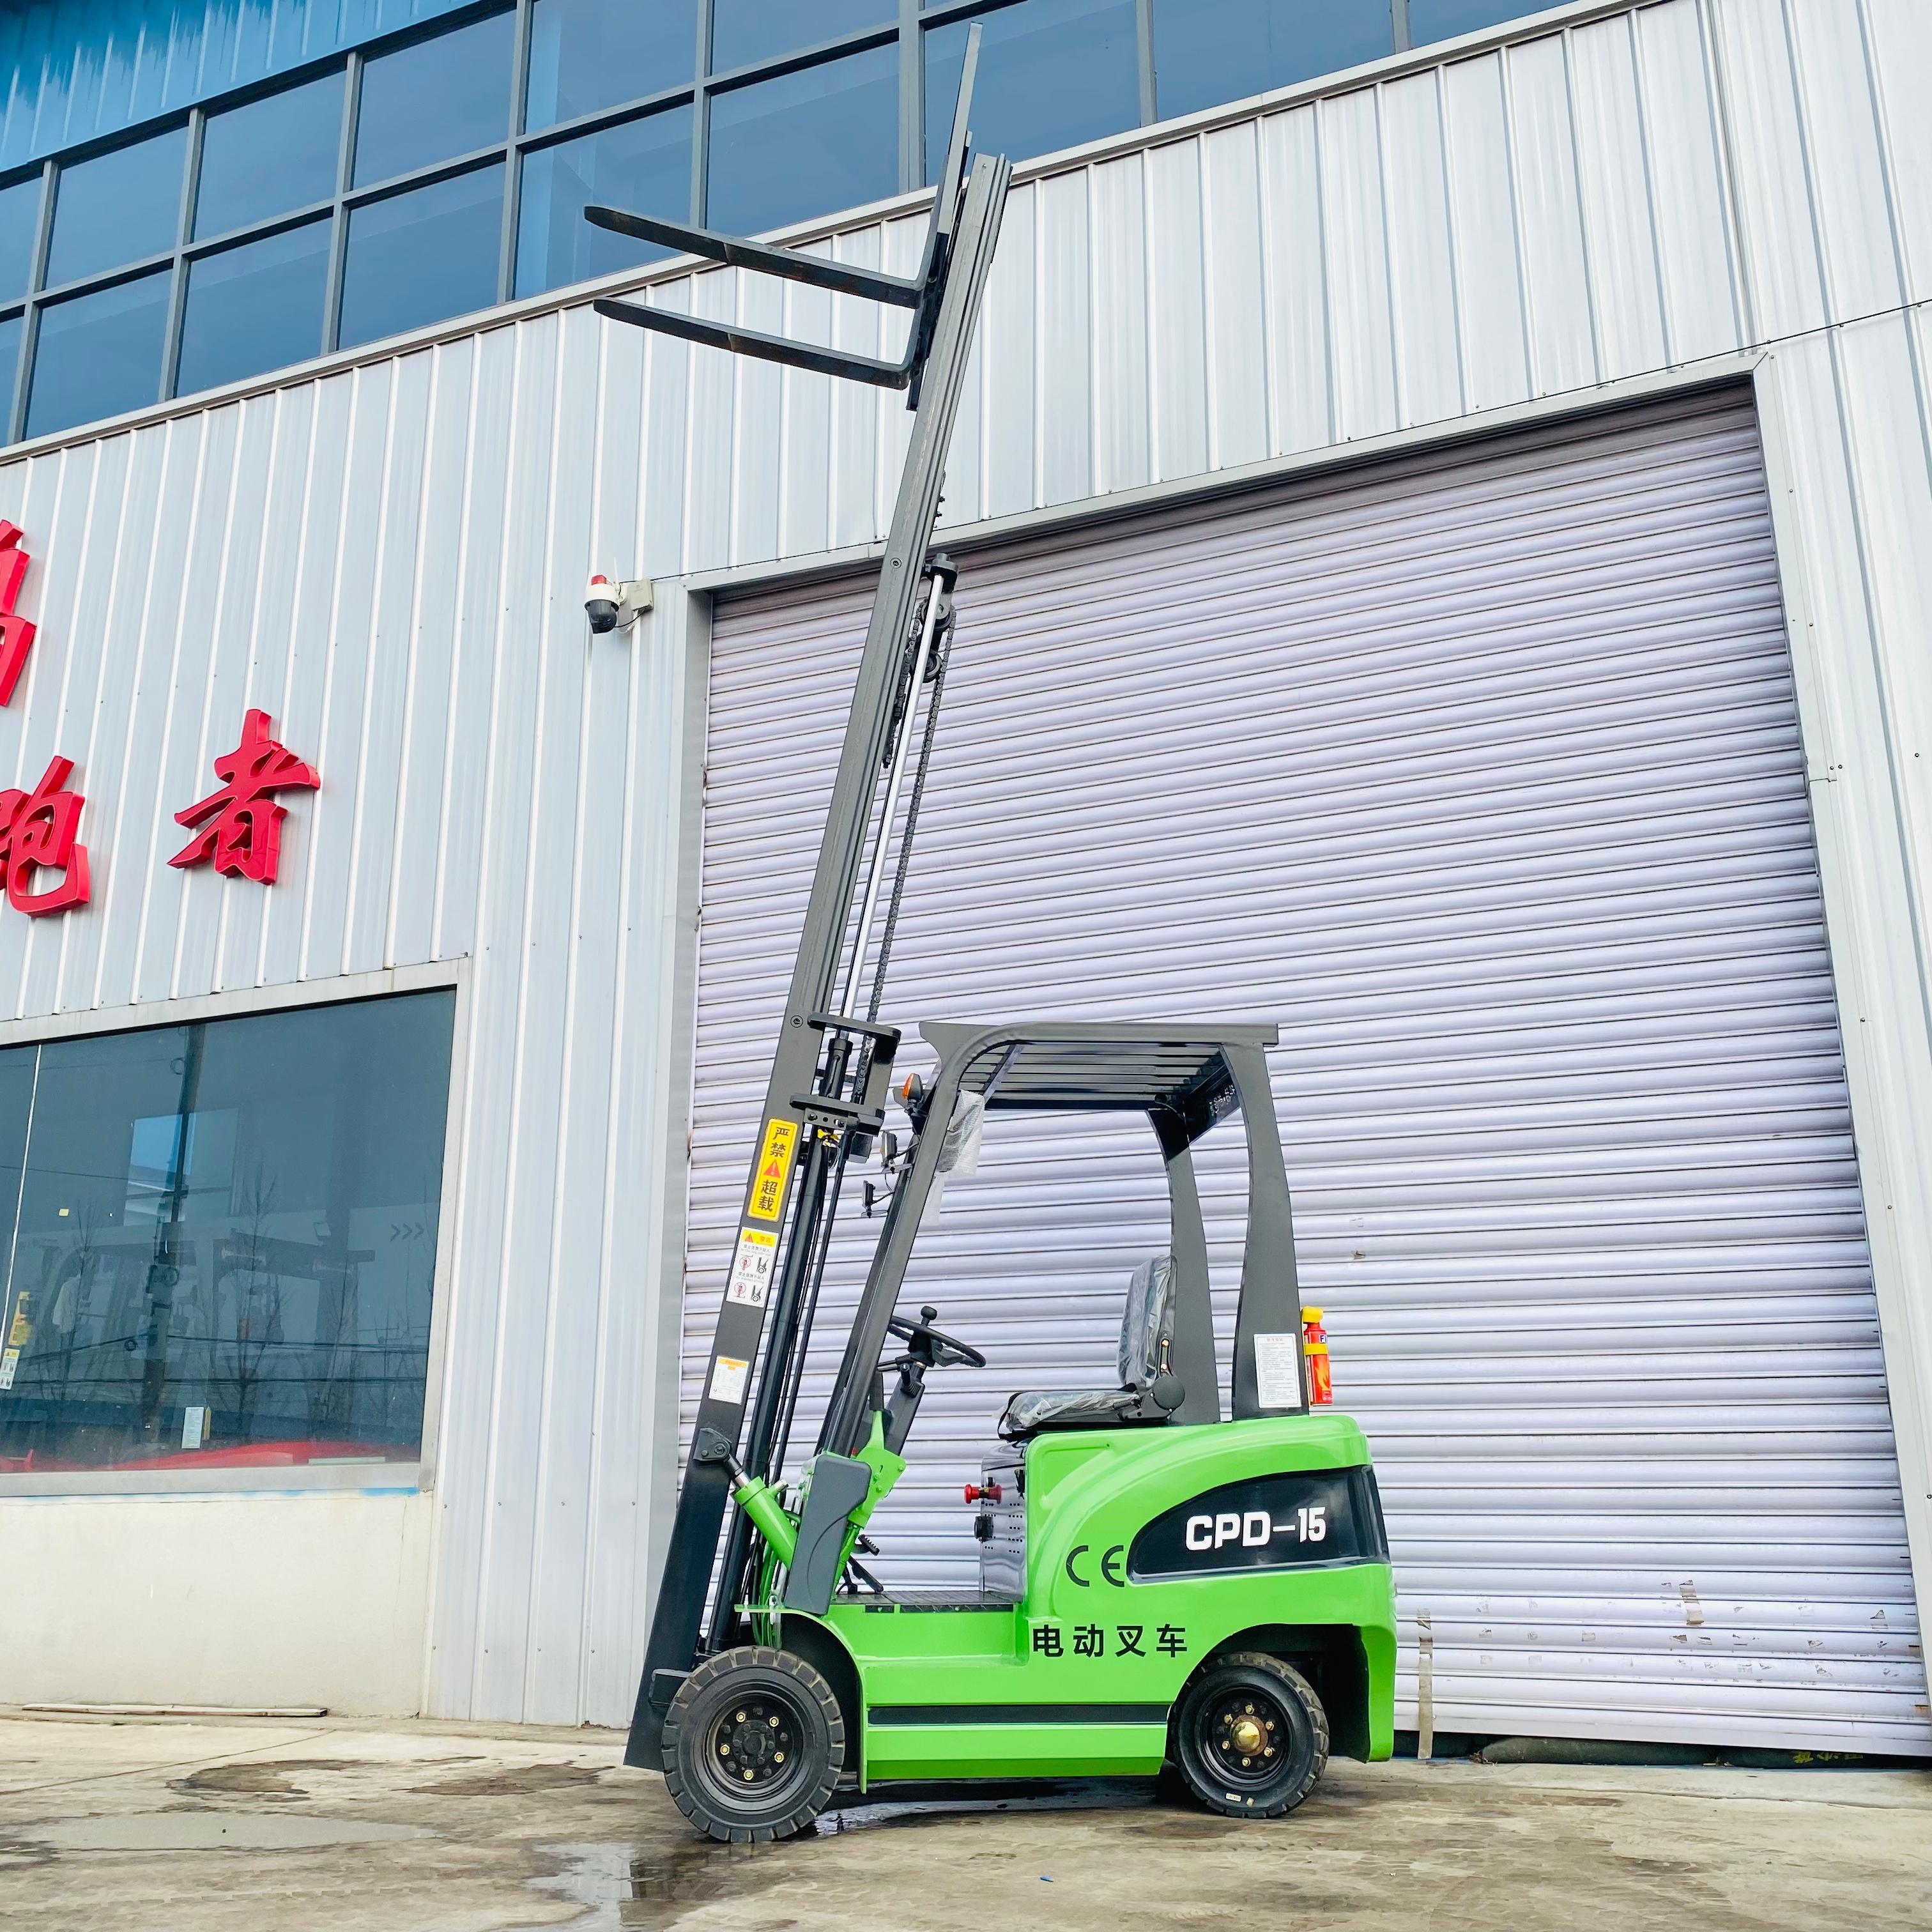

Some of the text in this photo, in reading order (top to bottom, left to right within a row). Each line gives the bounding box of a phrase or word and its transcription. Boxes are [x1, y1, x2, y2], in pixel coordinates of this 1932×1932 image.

[1185, 1506, 1326, 1551] CPD-15
[1066, 1545, 1125, 1588] CE
[1032, 1623, 1188, 1658] 电动叉车
